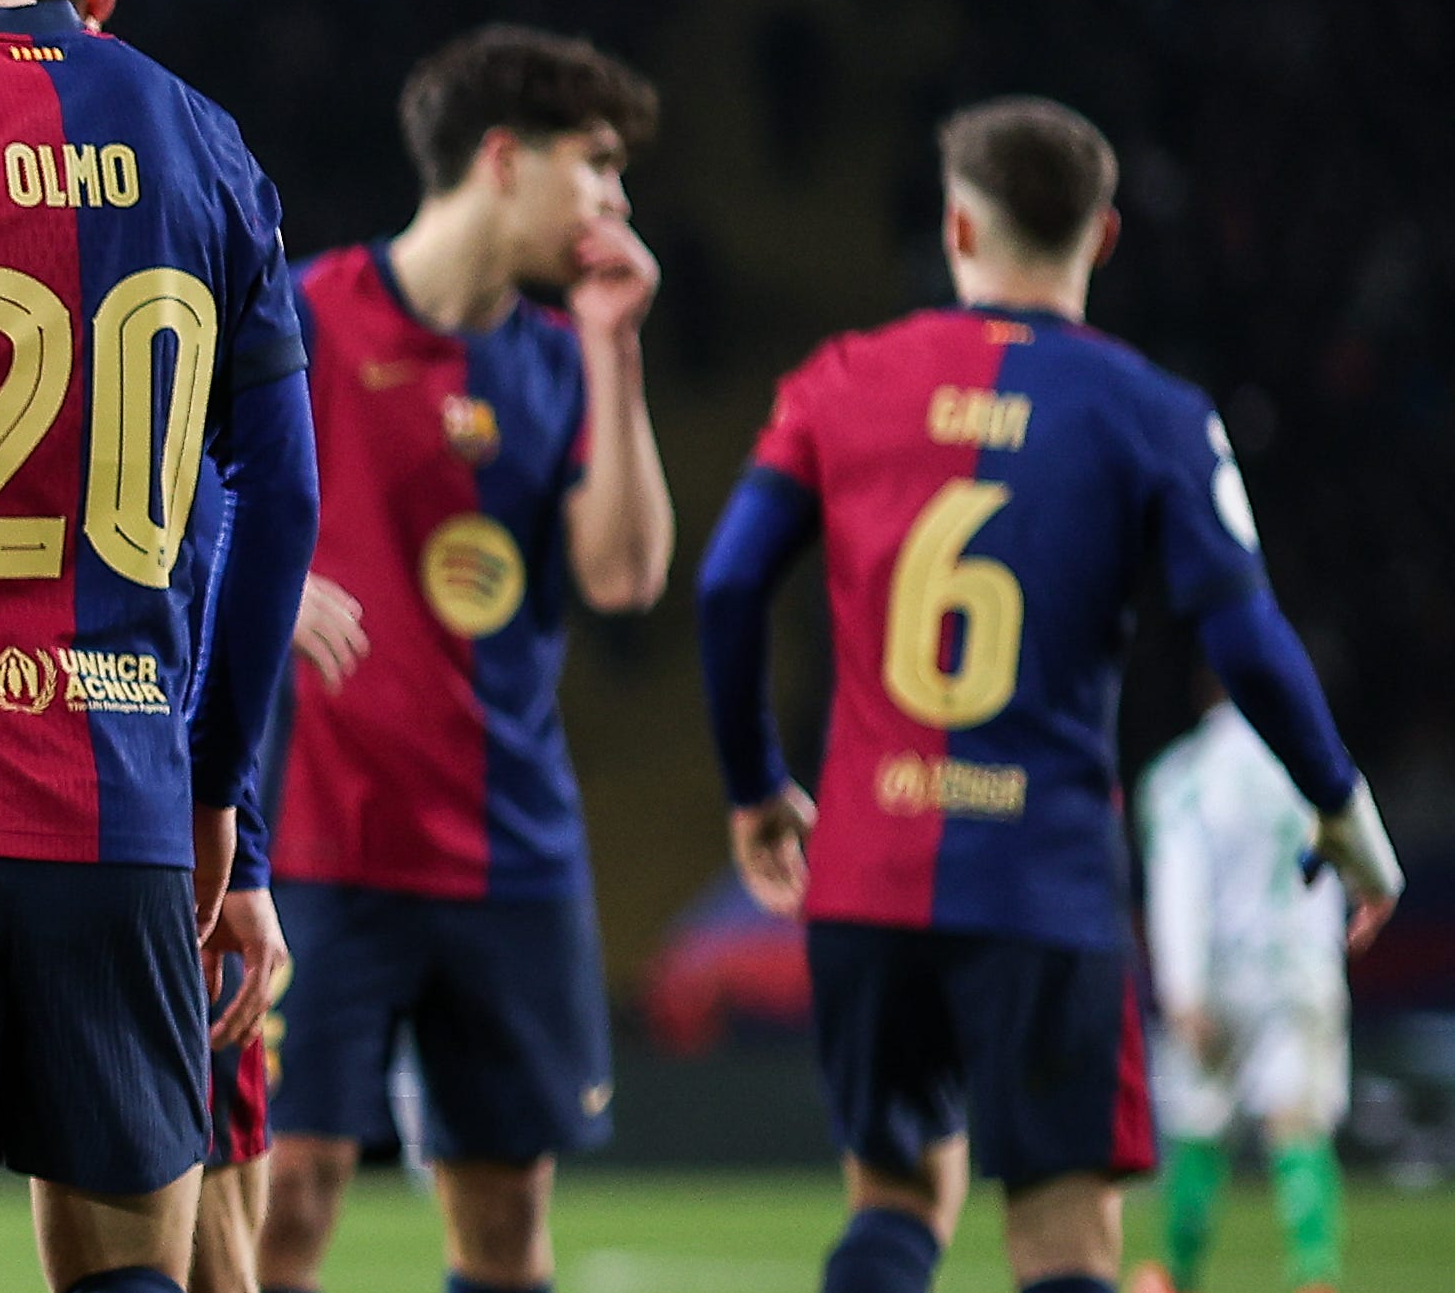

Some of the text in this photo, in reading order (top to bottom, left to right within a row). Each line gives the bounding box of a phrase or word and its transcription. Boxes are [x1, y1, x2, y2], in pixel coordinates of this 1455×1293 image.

[4, 142, 140, 208] OLMO
[885, 481, 1023, 725] 6
[57, 647, 158, 683] UNHCR
[64, 672, 168, 703] ACNUR
